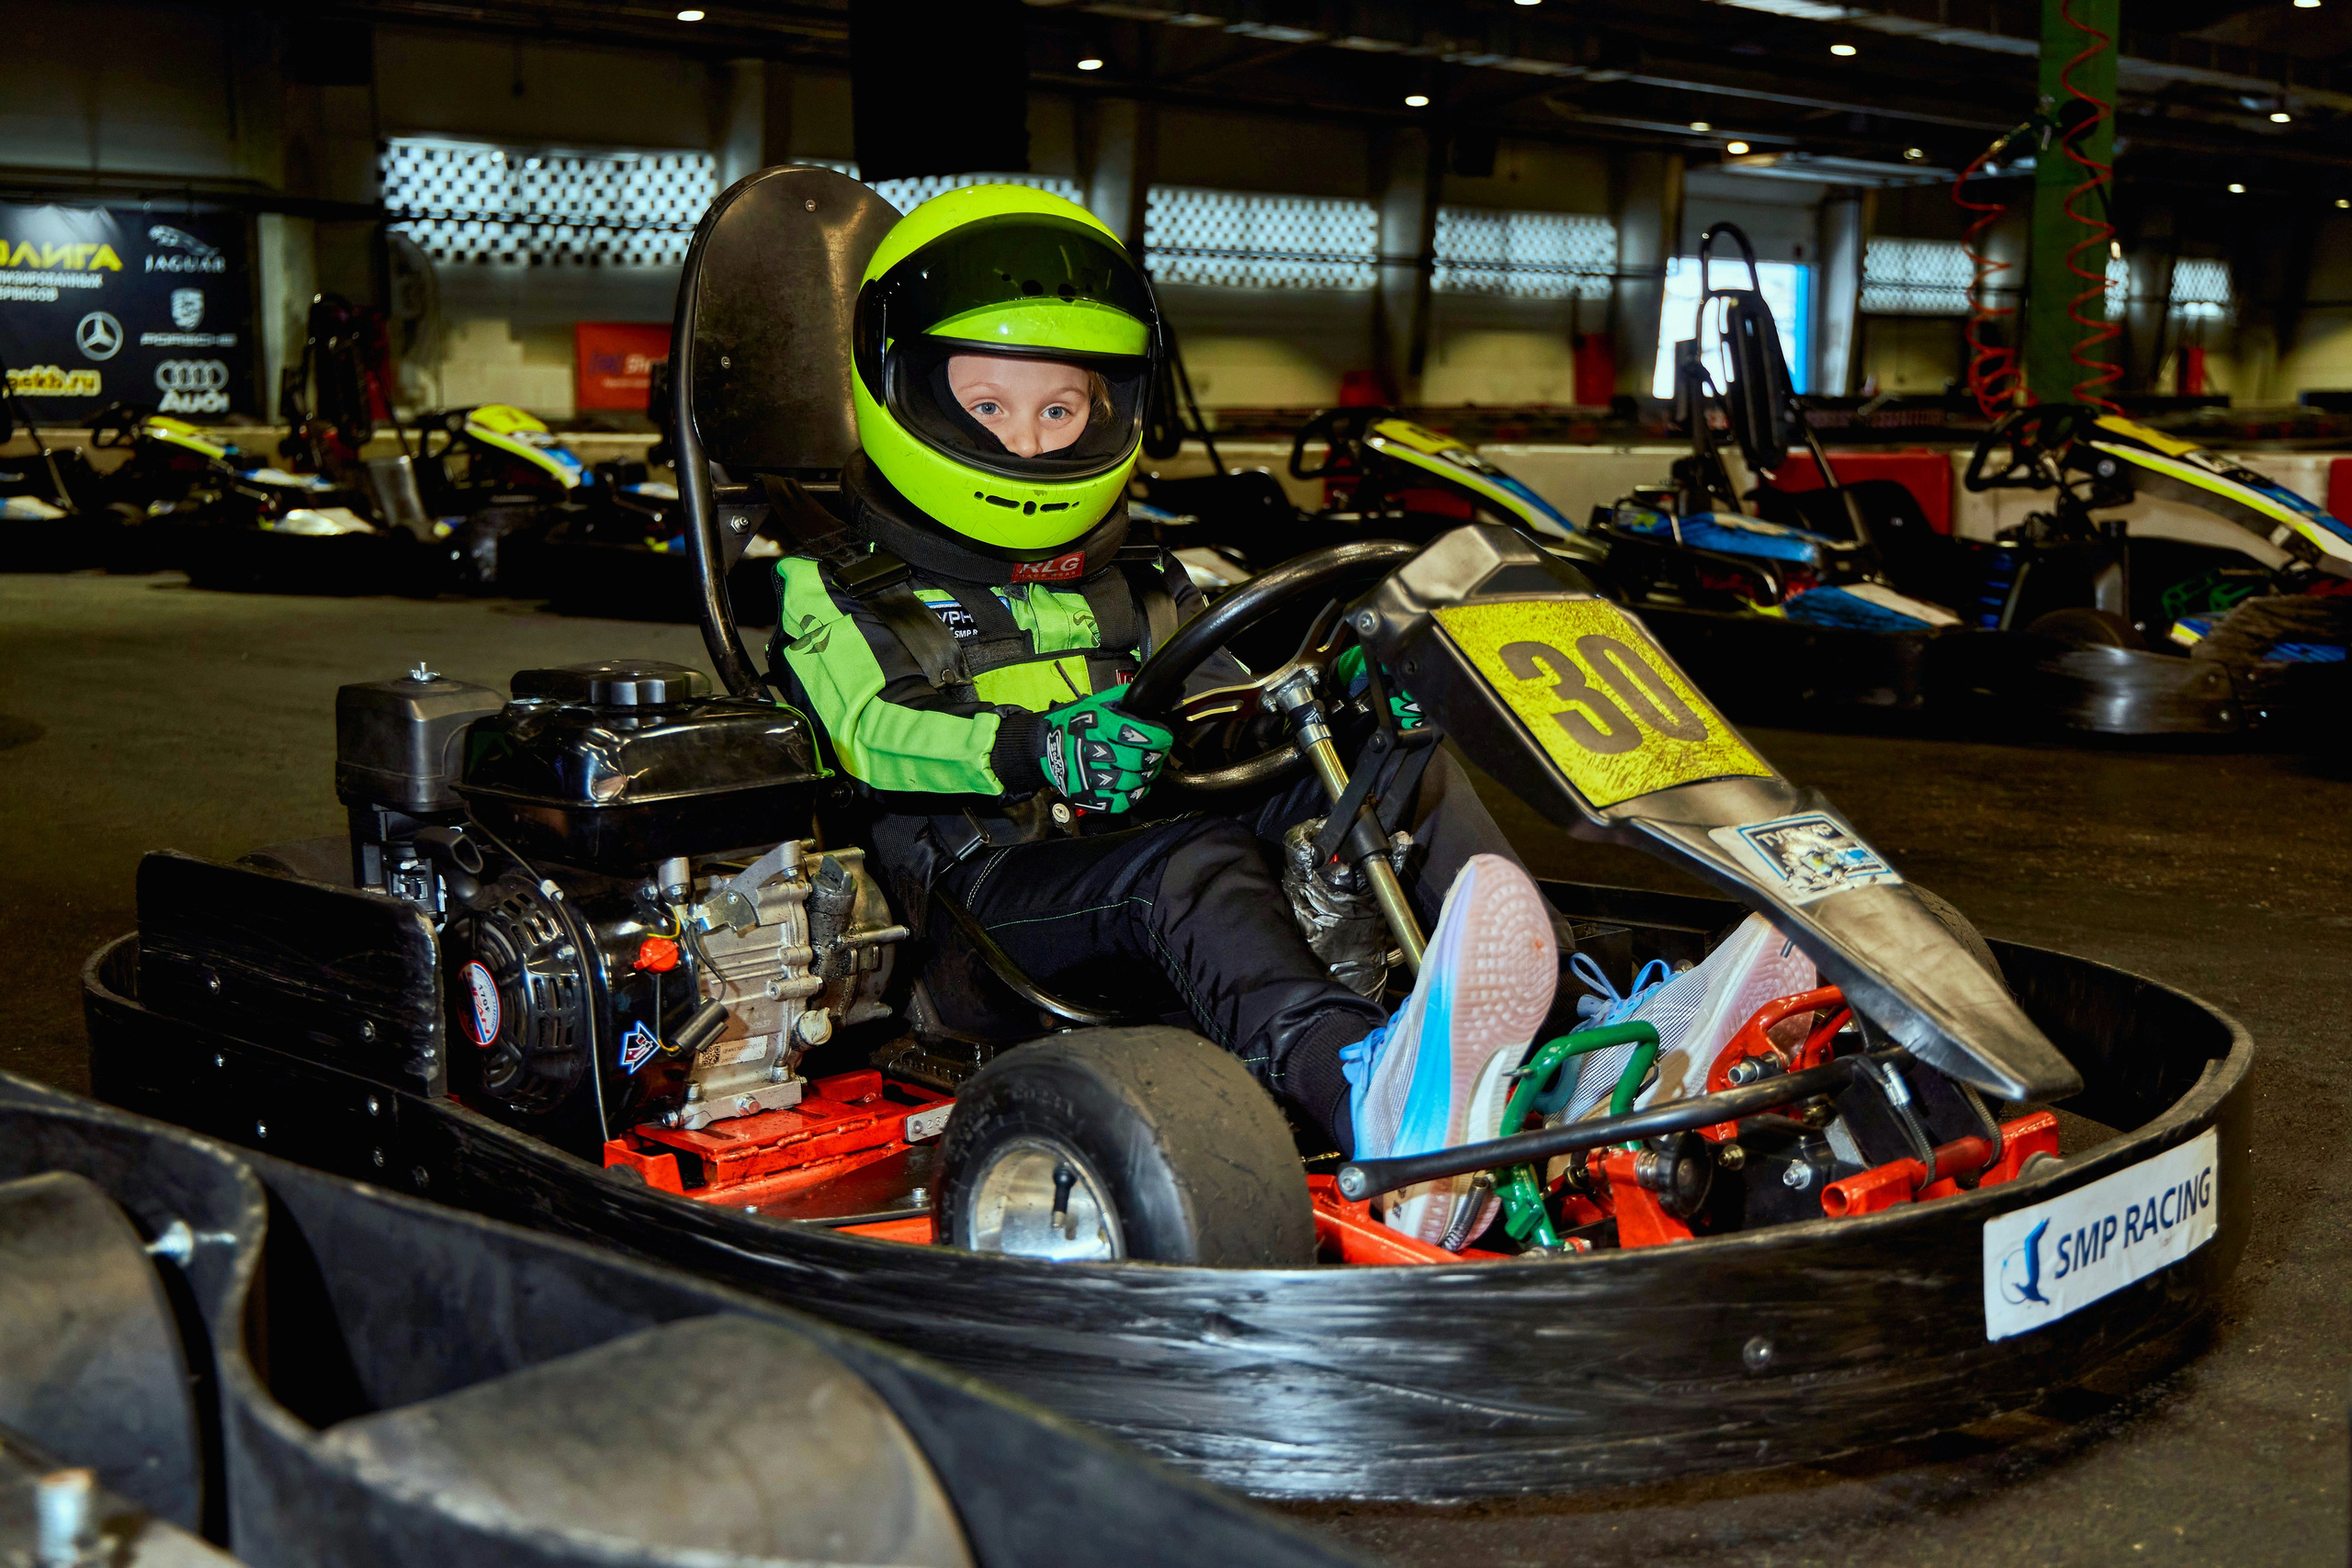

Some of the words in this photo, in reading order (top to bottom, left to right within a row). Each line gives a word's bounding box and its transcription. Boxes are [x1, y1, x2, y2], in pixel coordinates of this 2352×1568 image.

[145, 254, 226, 273] JAGUAR
[1019, 557, 1080, 574] RLG
[954, 629, 971, 638] SMP
[1498, 634, 1709, 755] 30
[2054, 1214, 2118, 1280] SMP
[2123, 1166, 2211, 1249] RACING
